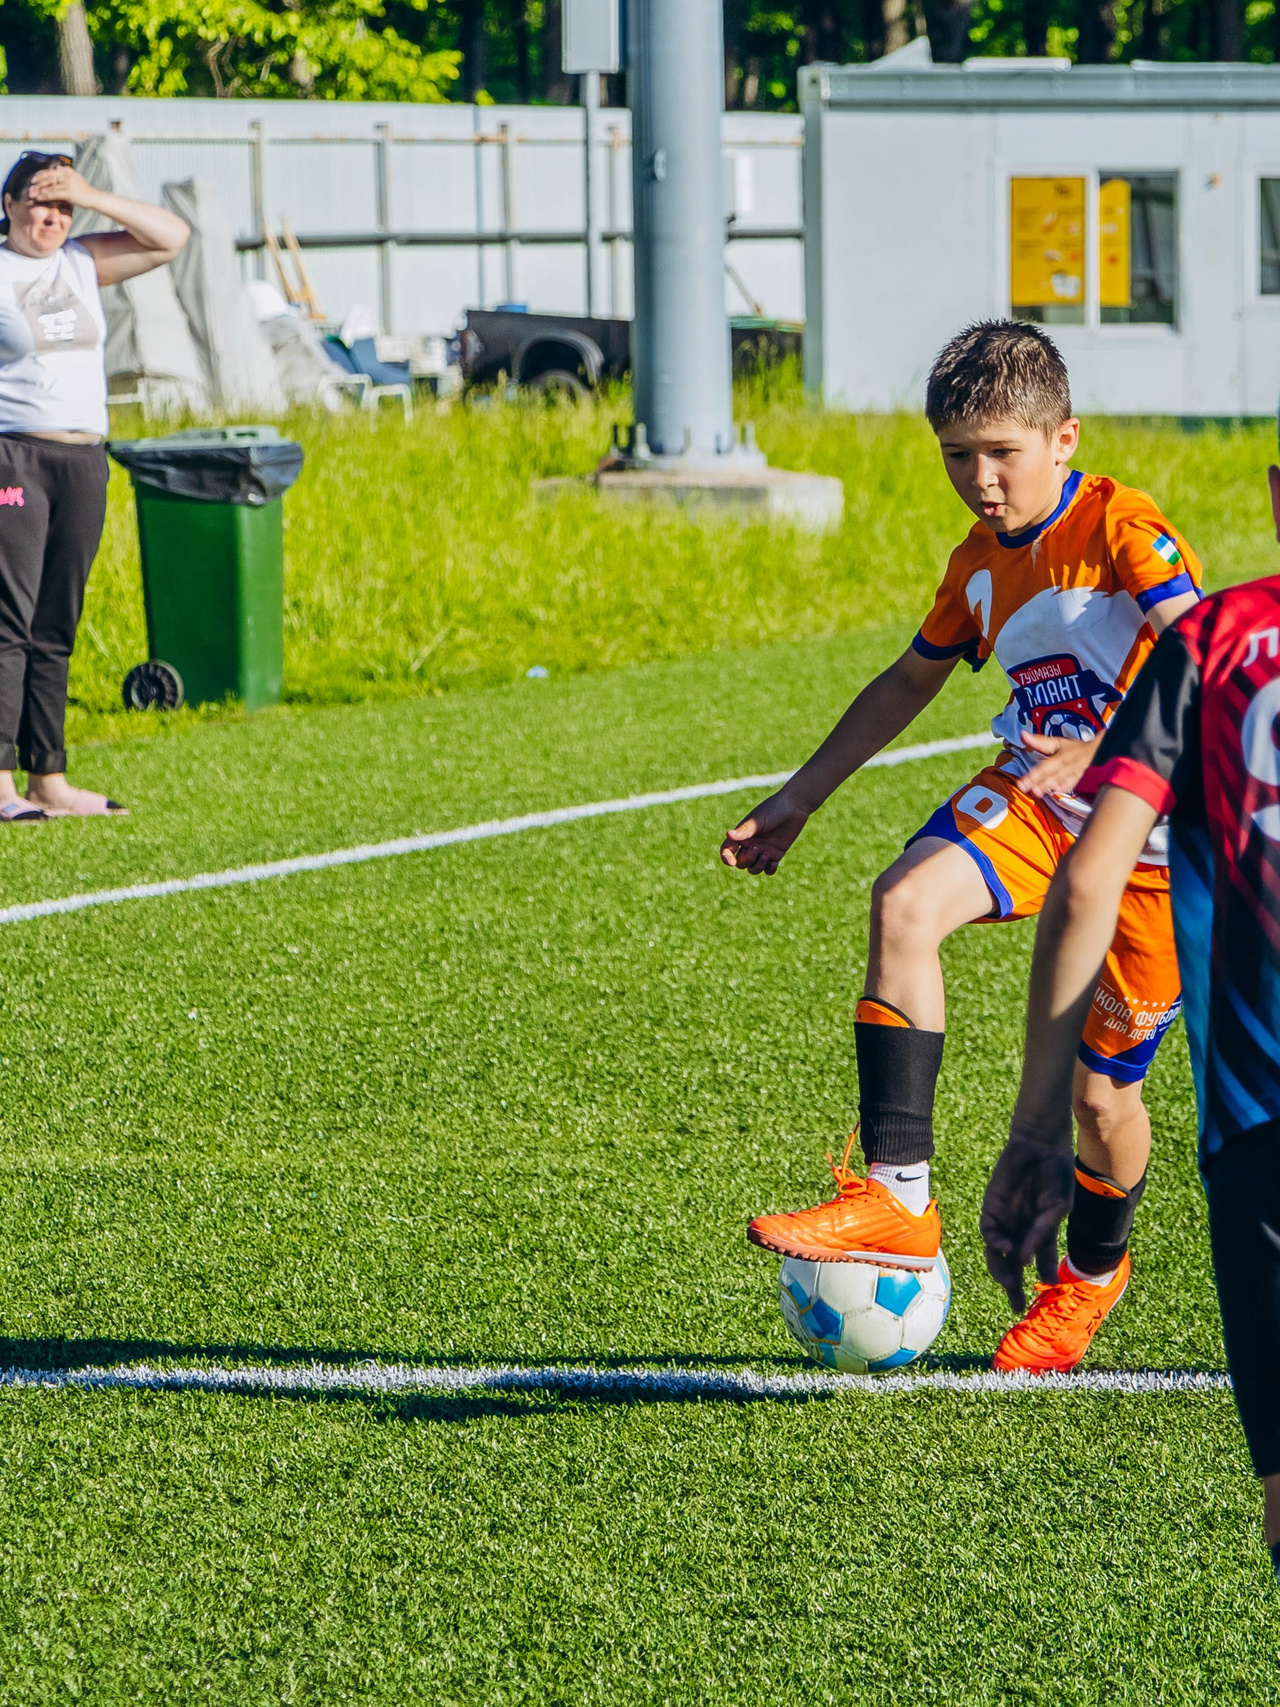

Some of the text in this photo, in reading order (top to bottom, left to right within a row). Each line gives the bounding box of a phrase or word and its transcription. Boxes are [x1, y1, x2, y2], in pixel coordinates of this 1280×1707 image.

[1019, 664, 1062, 685] ТУЙМАЗЫ
[1104, 1017, 1157, 1040] ДЛЯ ДЕТЕЙ
